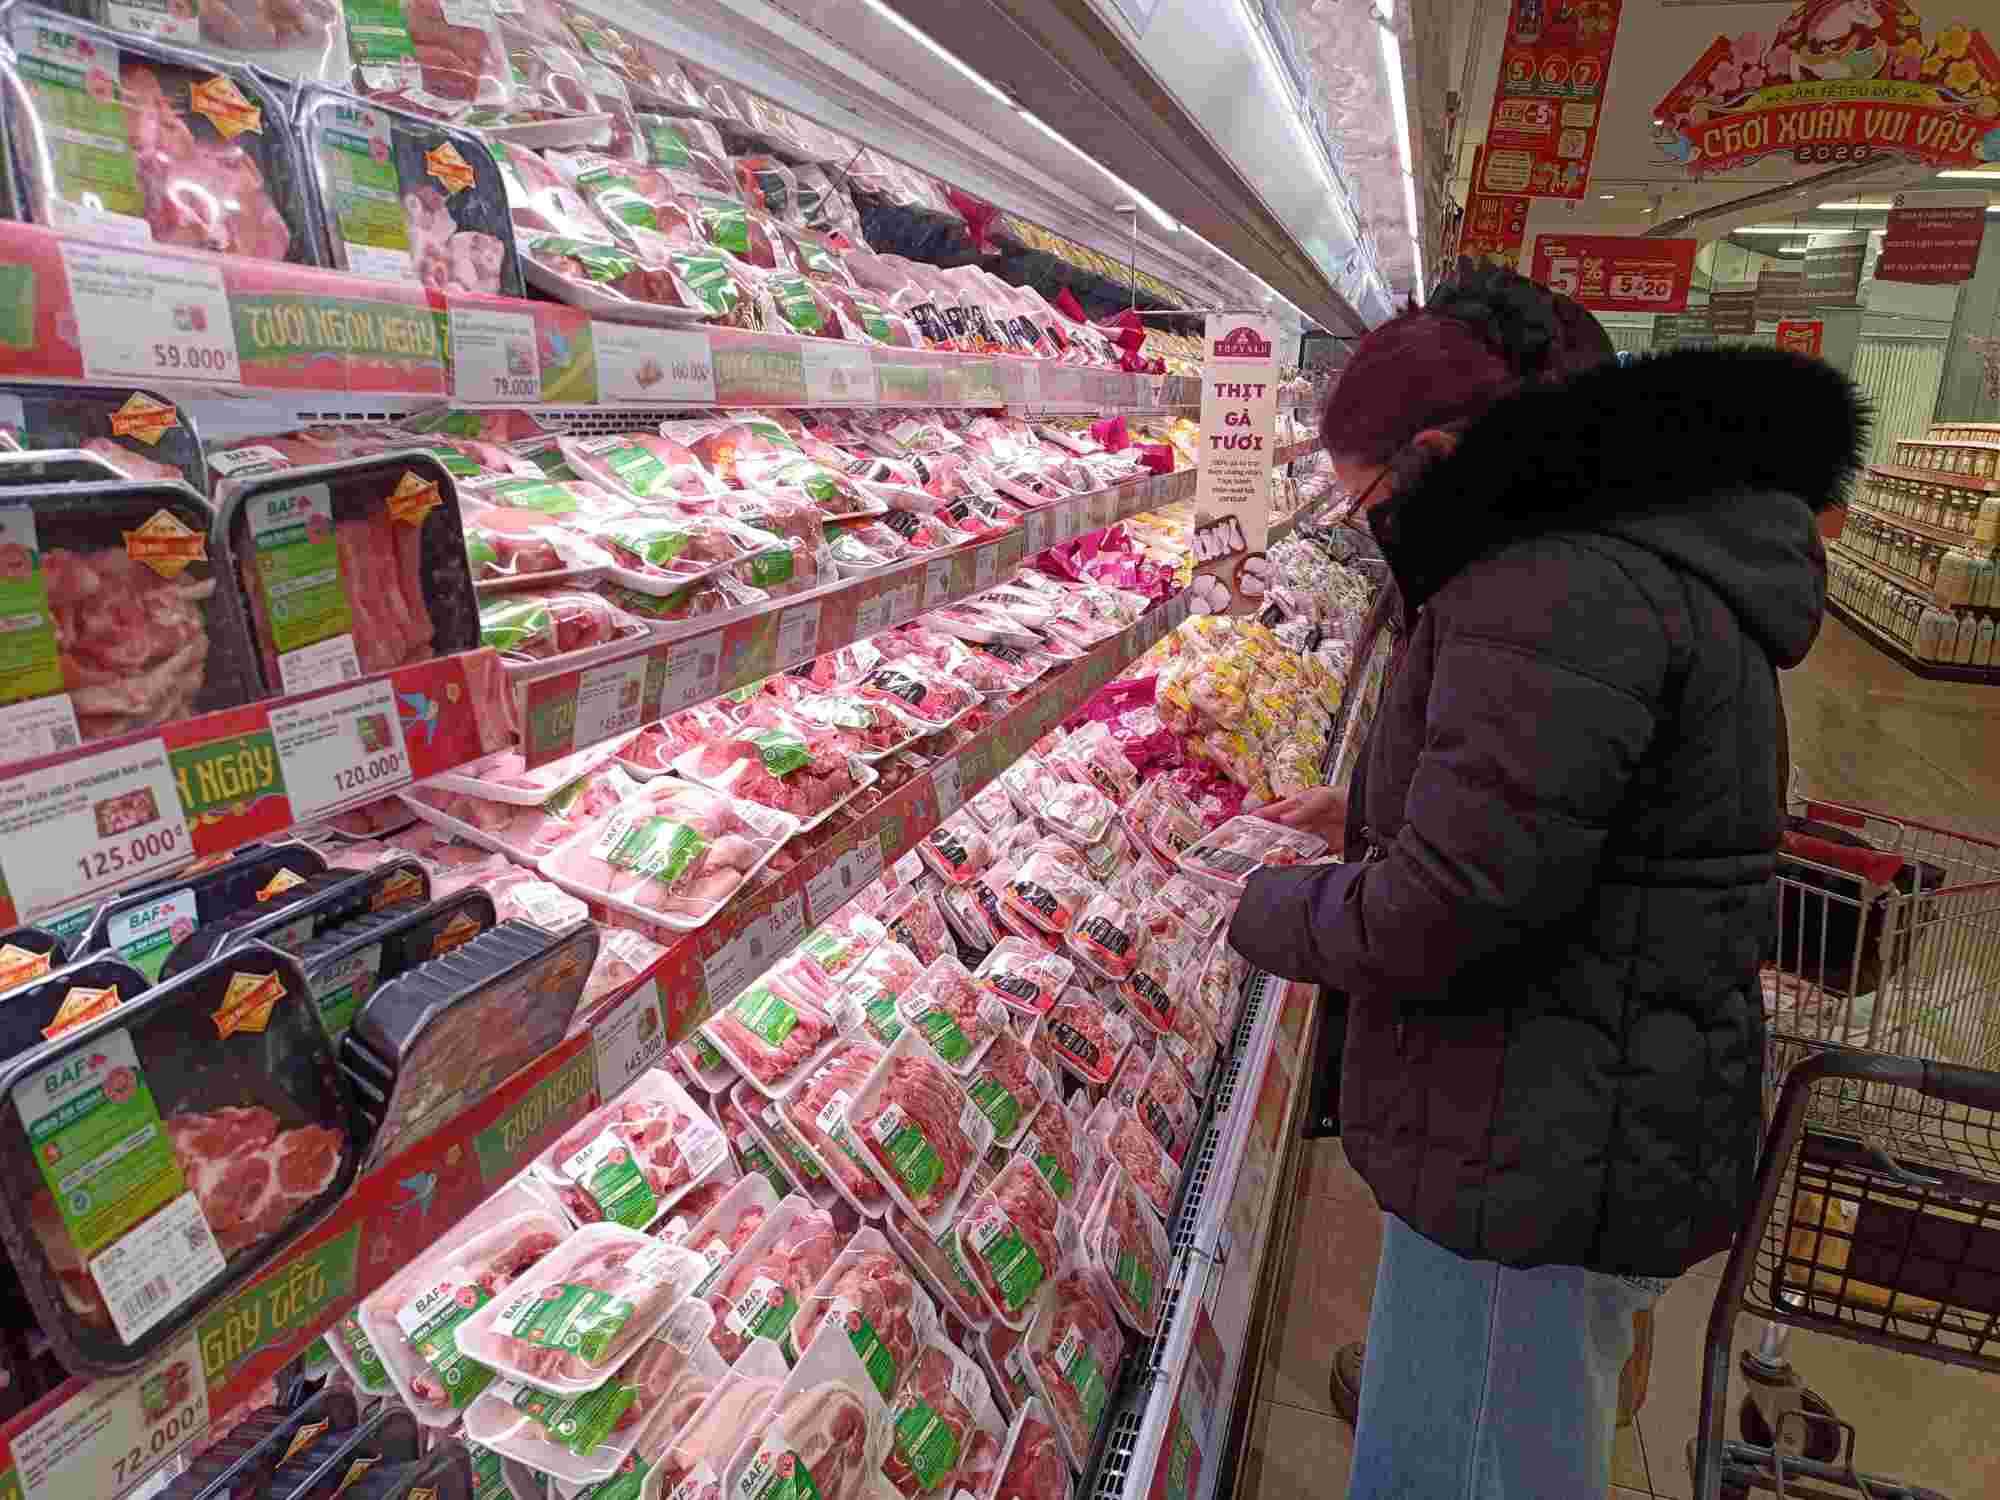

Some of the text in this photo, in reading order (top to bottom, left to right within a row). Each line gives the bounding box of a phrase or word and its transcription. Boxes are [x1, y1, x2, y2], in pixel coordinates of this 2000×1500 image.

[1775, 101, 1856, 147] XUÂN
[1862, 107, 1909, 146] VUI
[1214, 383, 1266, 402] THỊT
[1209, 433, 1263, 451] TƯƠI
[193, 736, 273, 802] NGÀY
[128, 906, 161, 930] BAF
[44, 1058, 87, 1095] BAF
[414, 1286, 442, 1314] BAF
[736, 1287, 762, 1317] BAF
[740, 1461, 763, 1498] BAF
